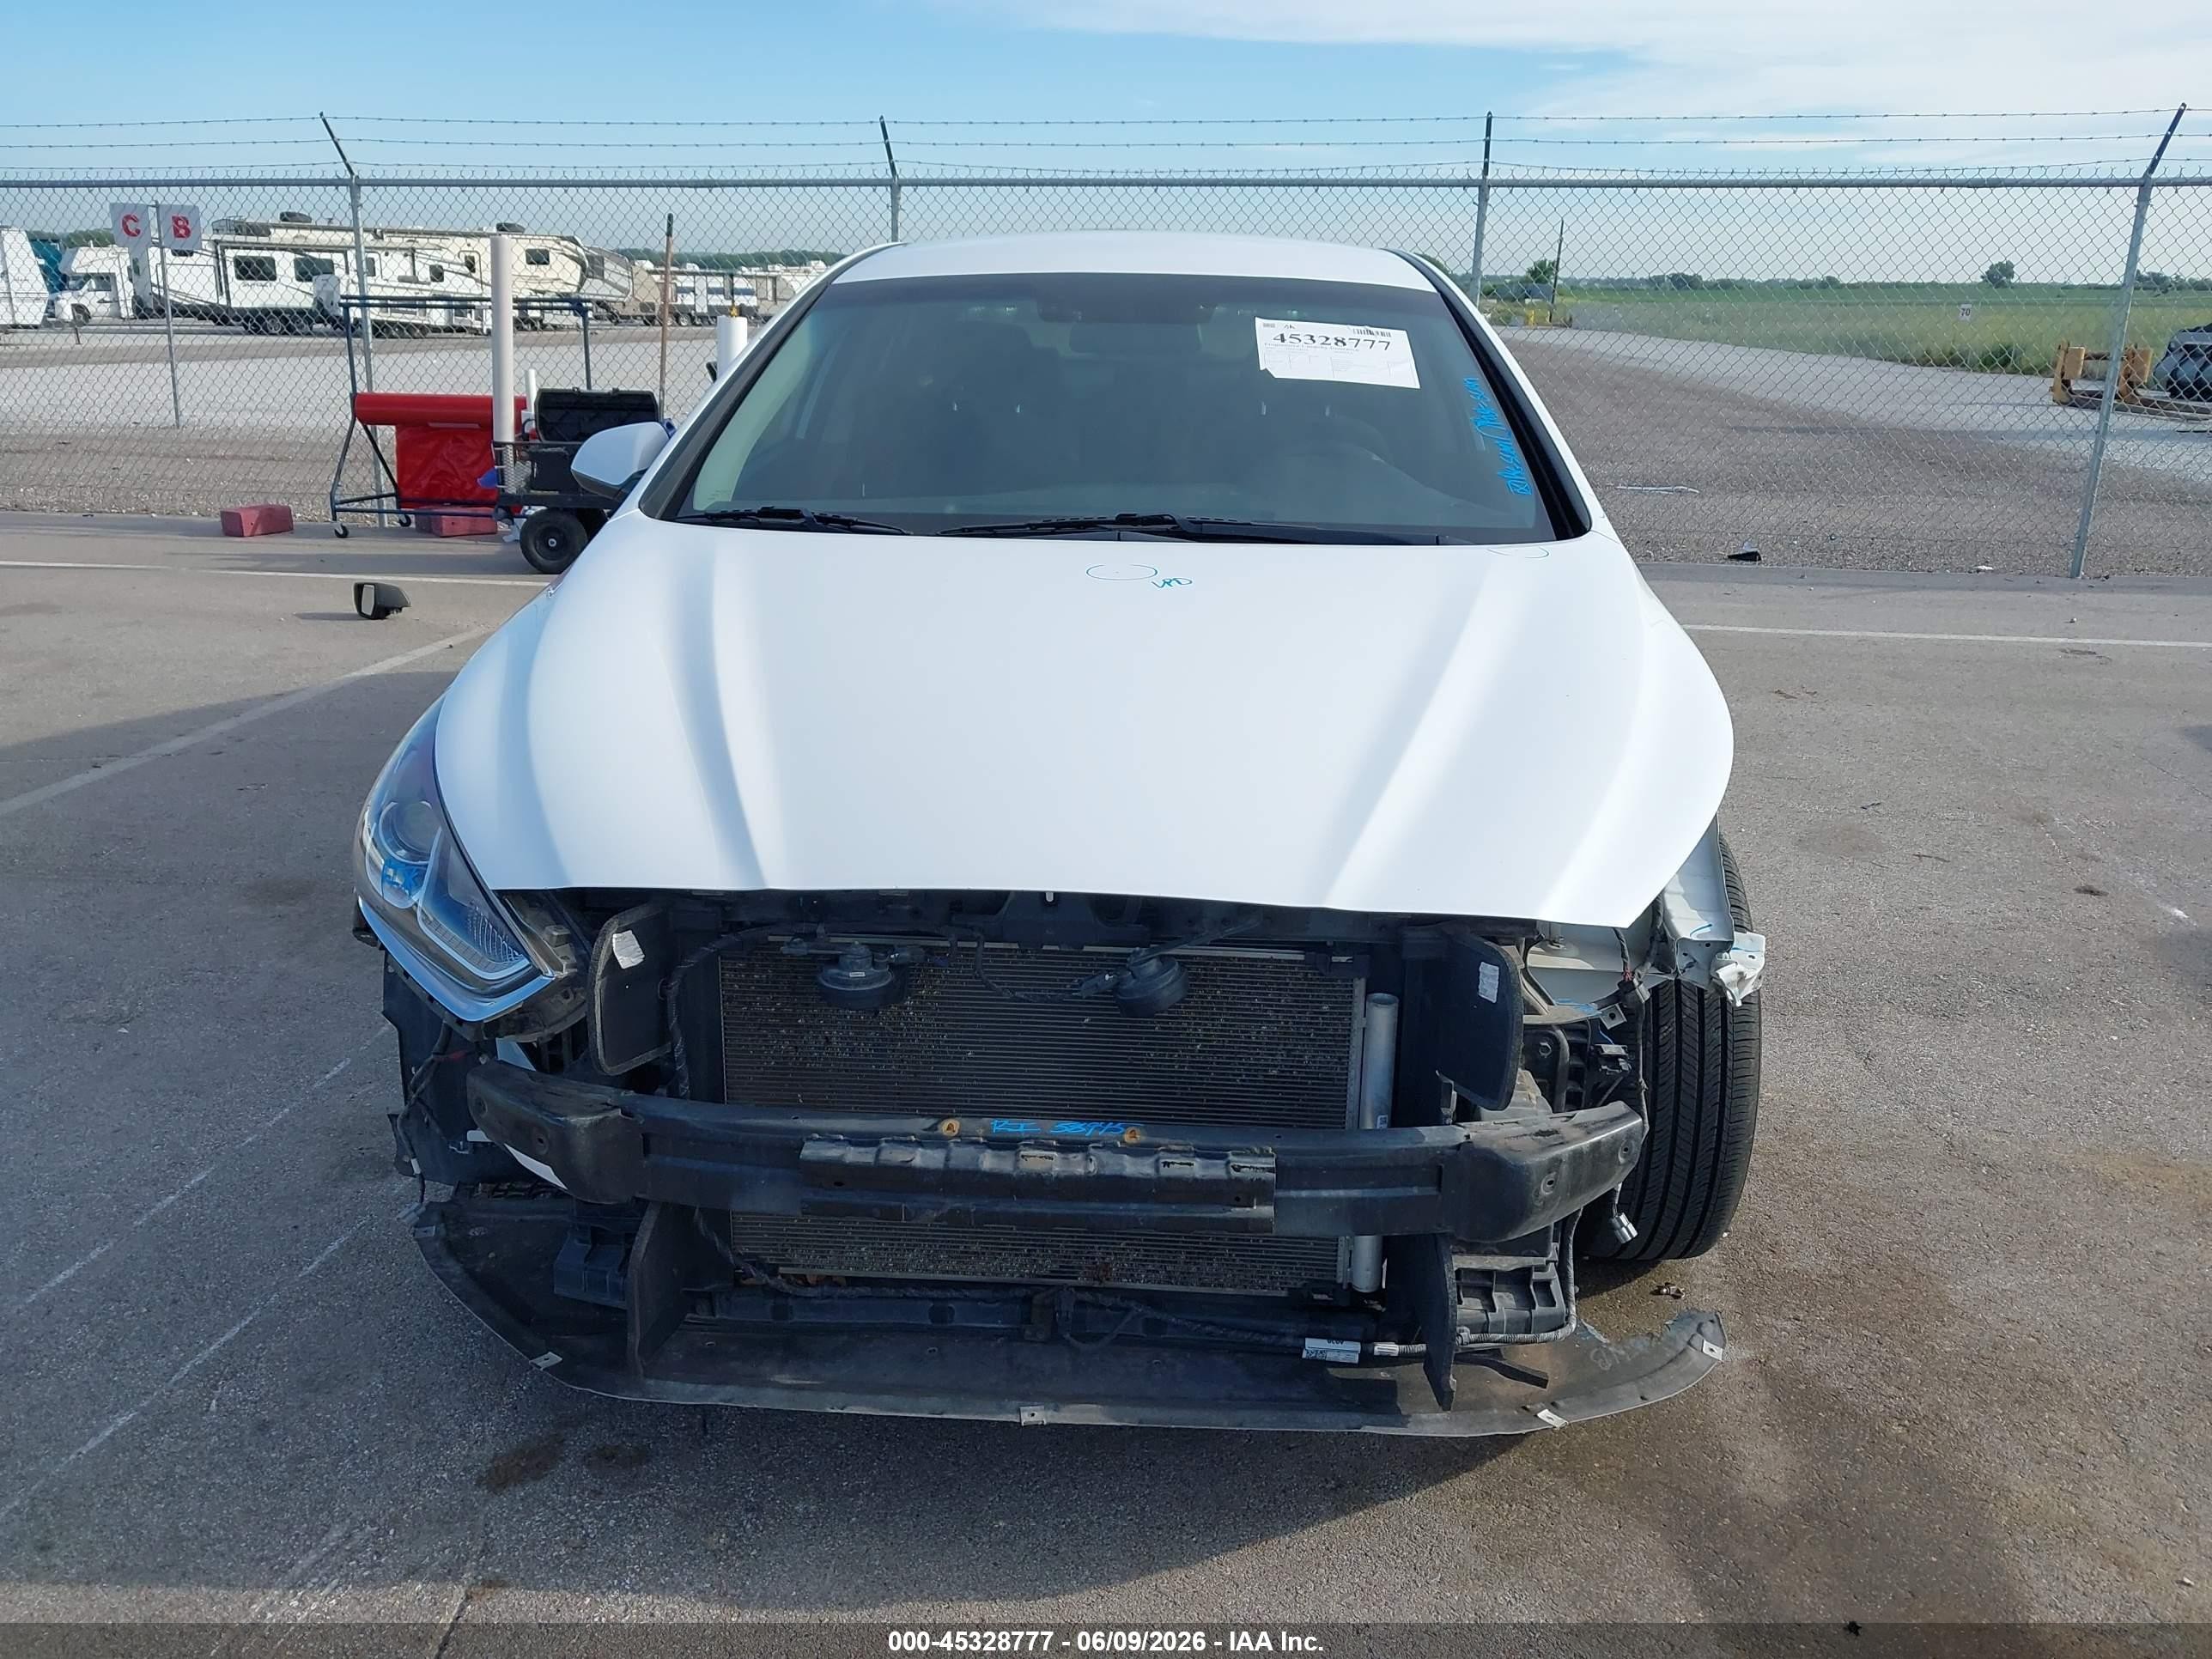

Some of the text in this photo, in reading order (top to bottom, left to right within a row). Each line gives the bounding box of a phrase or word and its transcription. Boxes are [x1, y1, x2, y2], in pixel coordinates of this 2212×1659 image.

[122, 214, 141, 237] C
[171, 215, 191, 239] B
[1960, 307, 1971, 317] 70
[1273, 332, 1390, 351] 45328777
